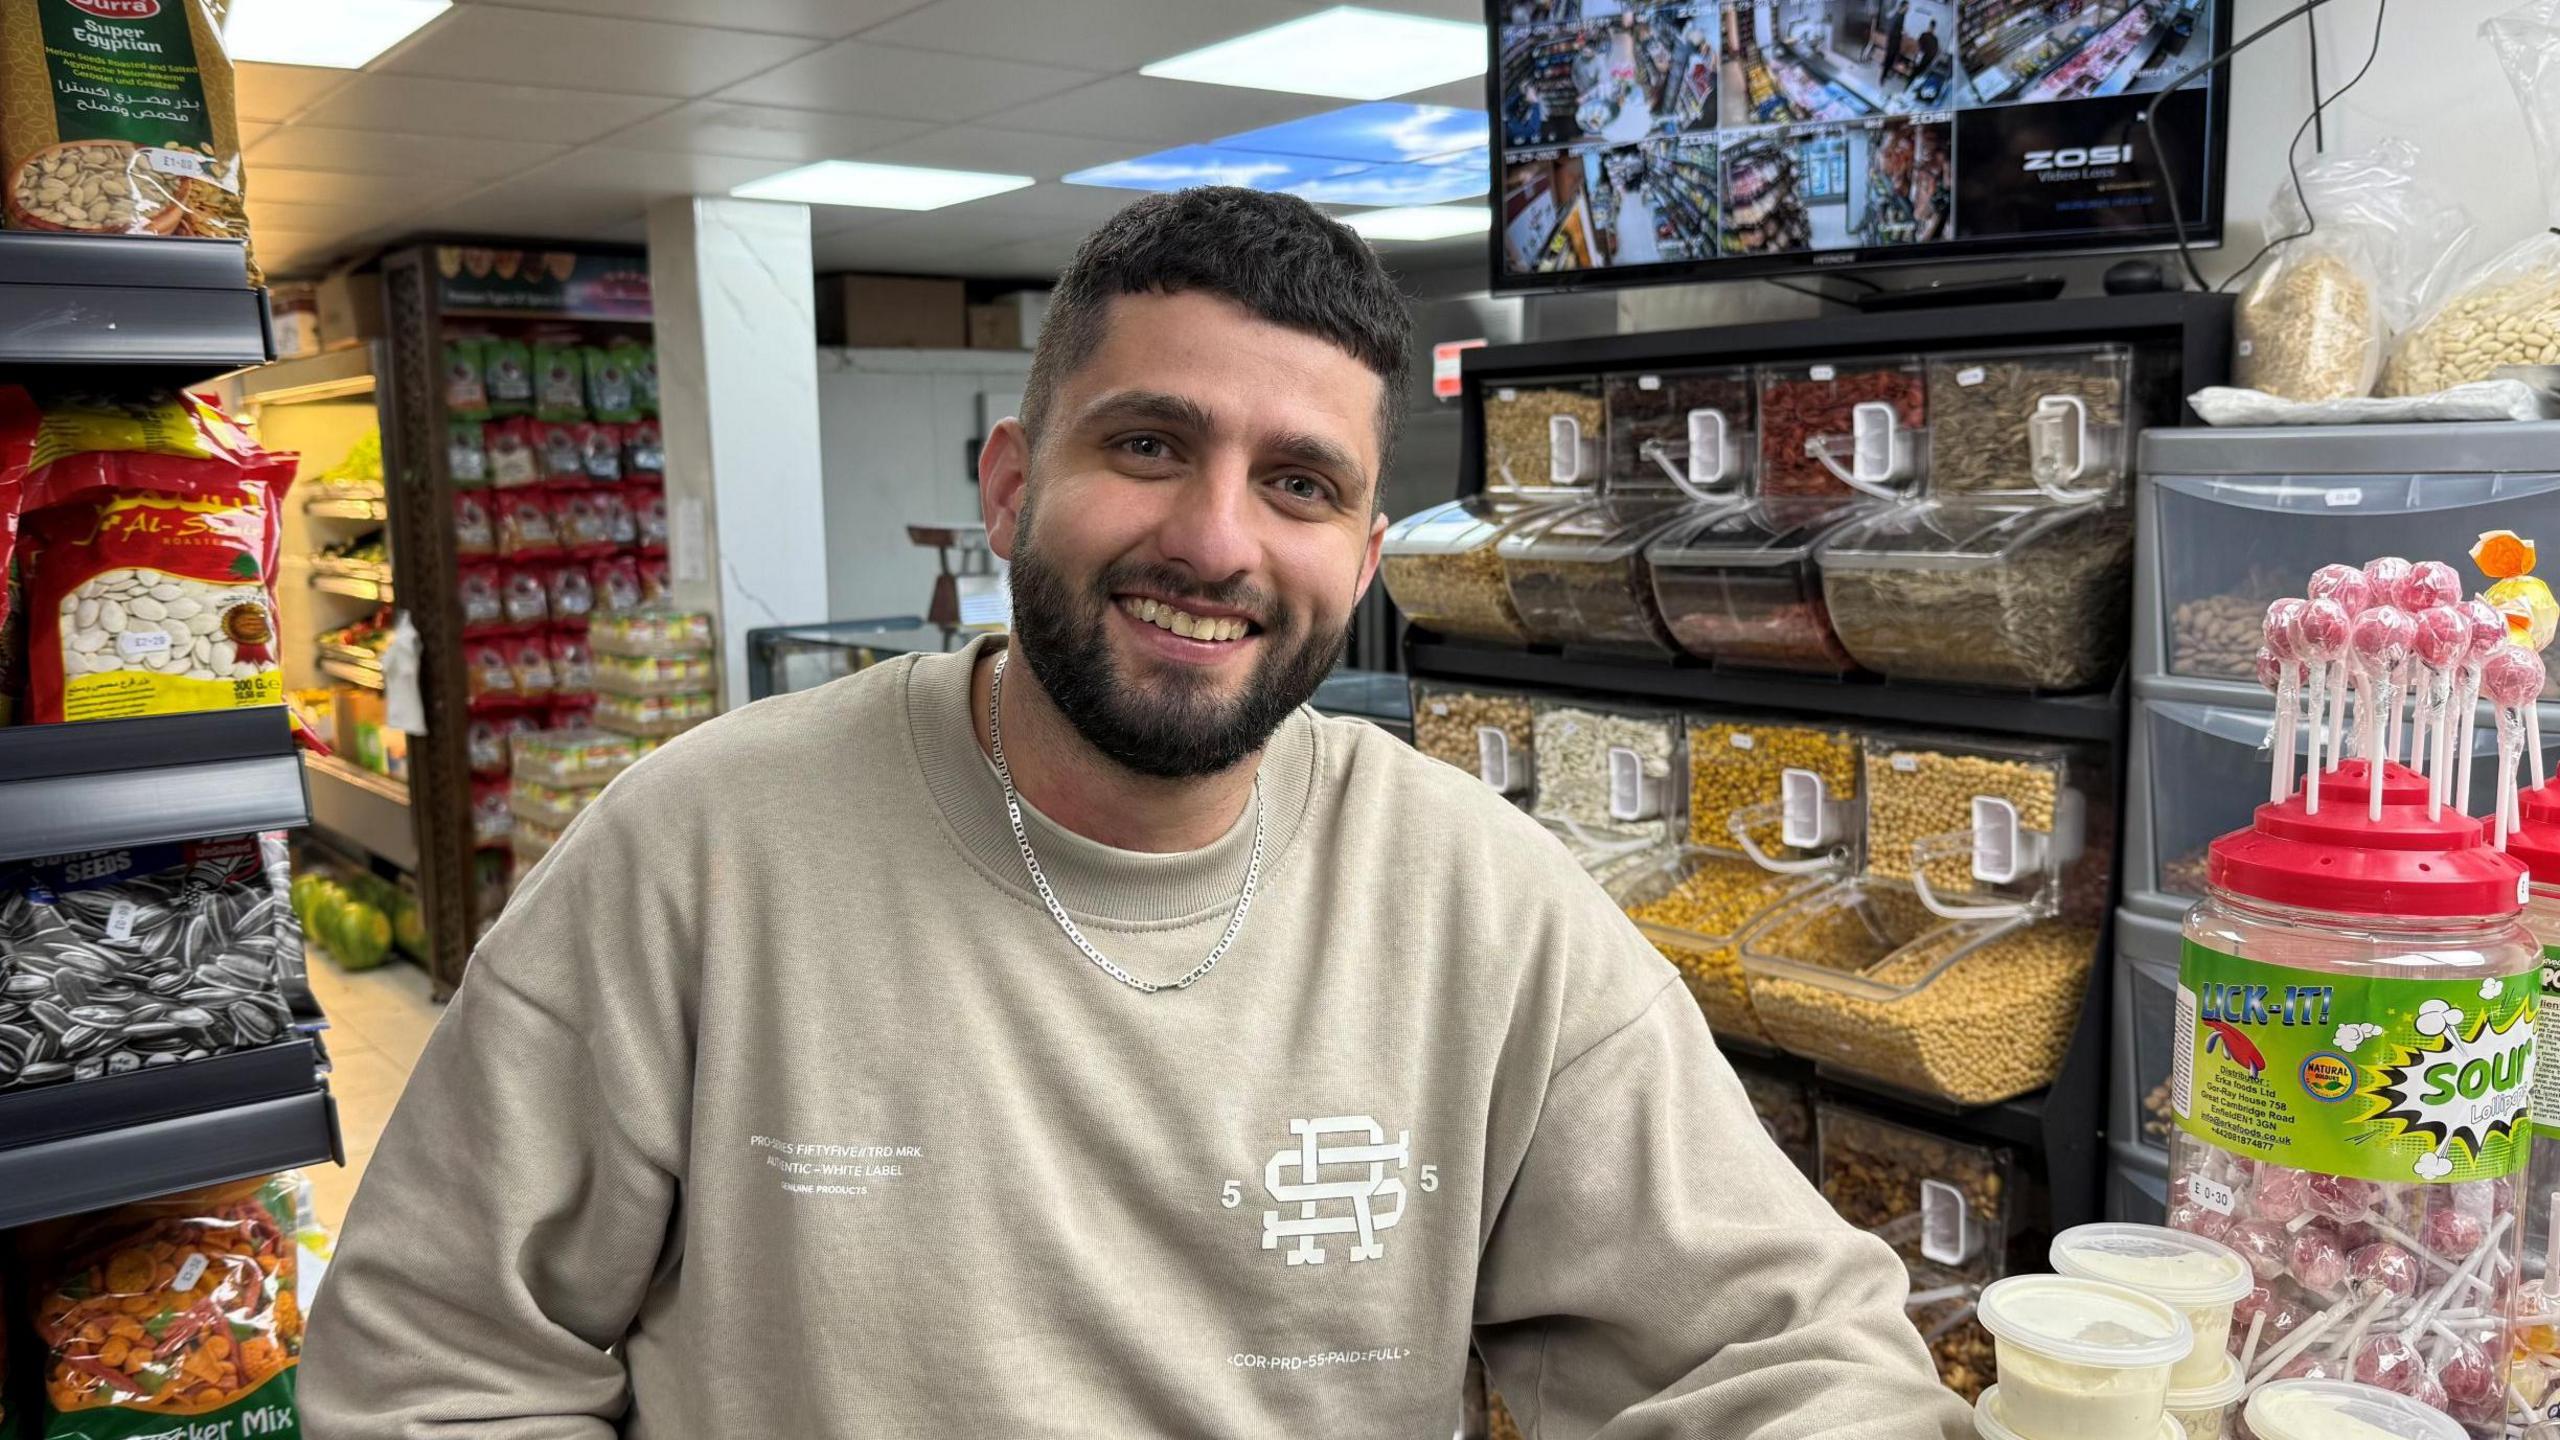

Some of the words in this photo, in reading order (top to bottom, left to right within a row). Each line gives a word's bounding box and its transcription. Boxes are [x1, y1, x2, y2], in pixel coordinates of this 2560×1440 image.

[72, 27, 163, 53] Egyptian
[84, 19, 145, 39] Super
[2022, 143, 2133, 171] ZOSI
[2037, 170, 2080, 183] Video
[2081, 167, 2117, 180] Loss
[233, 679, 253, 691] 300
[65, 850, 132, 883] SEEDS
[2201, 981, 2333, 1026] LICK-IT!
[2307, 1063, 2349, 1077] NATURAL
[2207, 1081, 2237, 1100] Gor-Ray
[2238, 1089, 2267, 1107] House
[2269, 1098, 2287, 1111] 758
[2215, 1074, 2232, 1087] Erka
[2233, 1078, 2258, 1094] foods
[2260, 1085, 2276, 1098] Ltd
[2201, 1090, 2219, 1103] Great
[2220, 1095, 2266, 1118] Cambridge
[2268, 1110, 2295, 1124] Road
[2255, 1117, 2277, 1130] 3GN
[865, 1164, 903, 1177] LABEL
[816, 1184, 868, 1195] PRODUCTS
[1220, 1180, 1241, 1209] 5
[1420, 1164, 1439, 1192] 5
[241, 1405, 293, 1438] Mix
